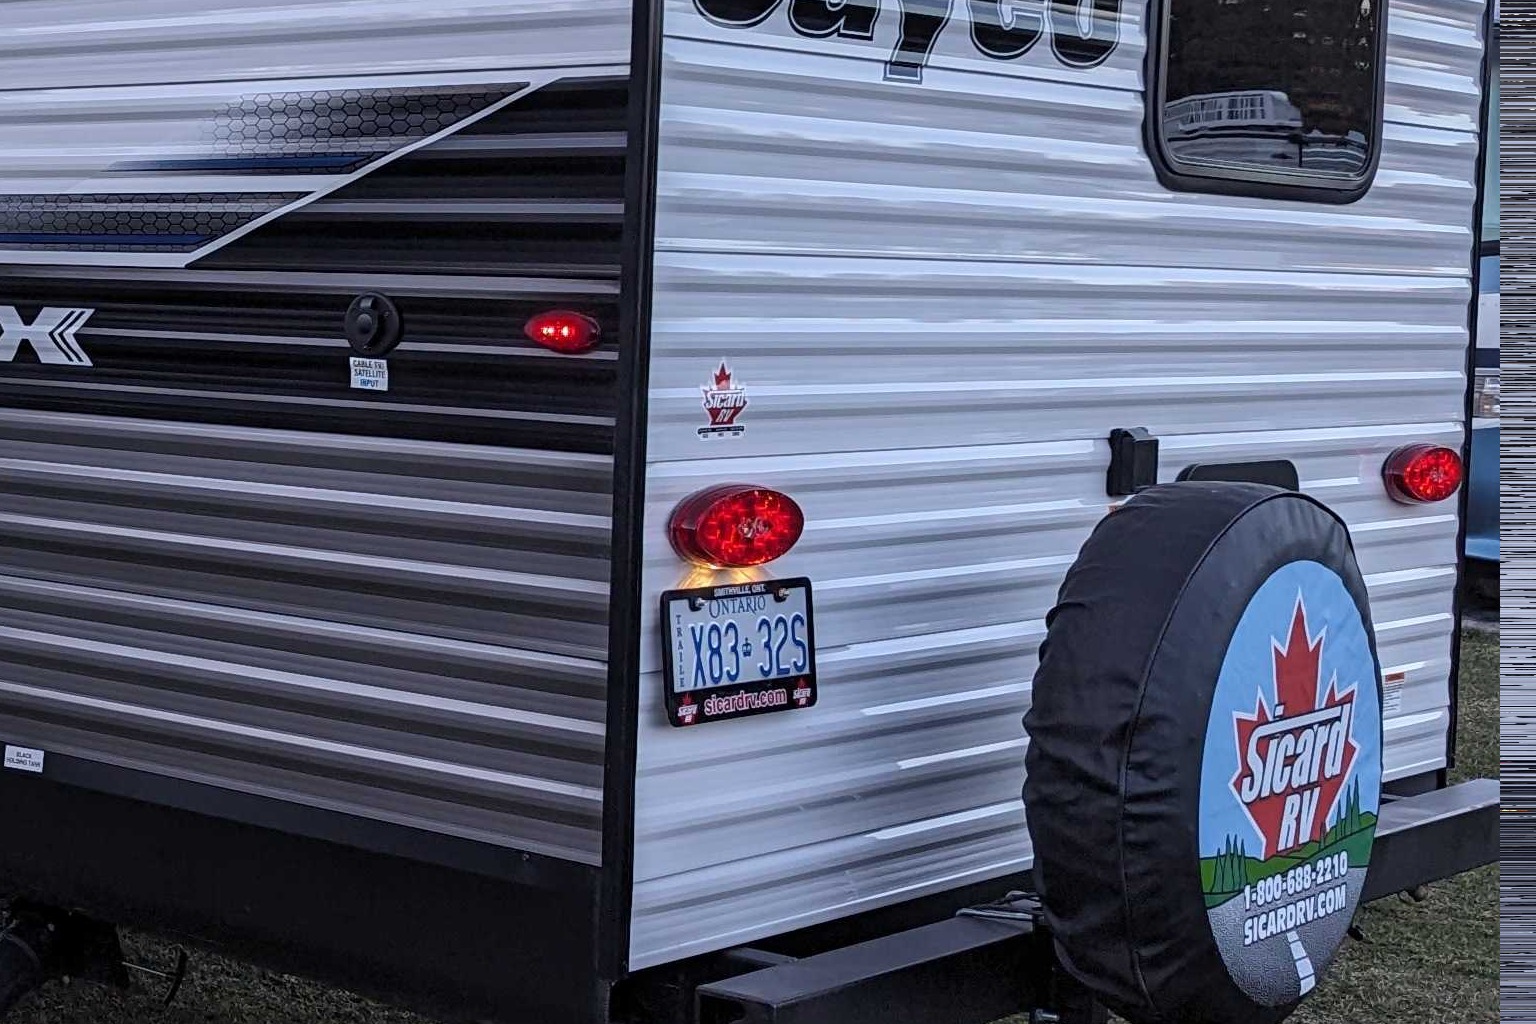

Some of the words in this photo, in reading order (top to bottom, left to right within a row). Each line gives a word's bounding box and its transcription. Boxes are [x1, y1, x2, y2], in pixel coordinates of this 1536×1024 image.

[353, 360, 373, 368] CABLE
[354, 369, 386, 379] SATELLITE
[360, 378, 379, 388] INPUT
[709, 595, 766, 618] ONTARIO
[689, 621, 740, 688] X83
[704, 688, 788, 716] sicardrv.com
[1241, 703, 1351, 804] Sicard
[1277, 786, 1321, 852] RV
[1243, 850, 1349, 910] 1-800-688-2210
[1243, 883, 1348, 946] SICARDRV.COM
